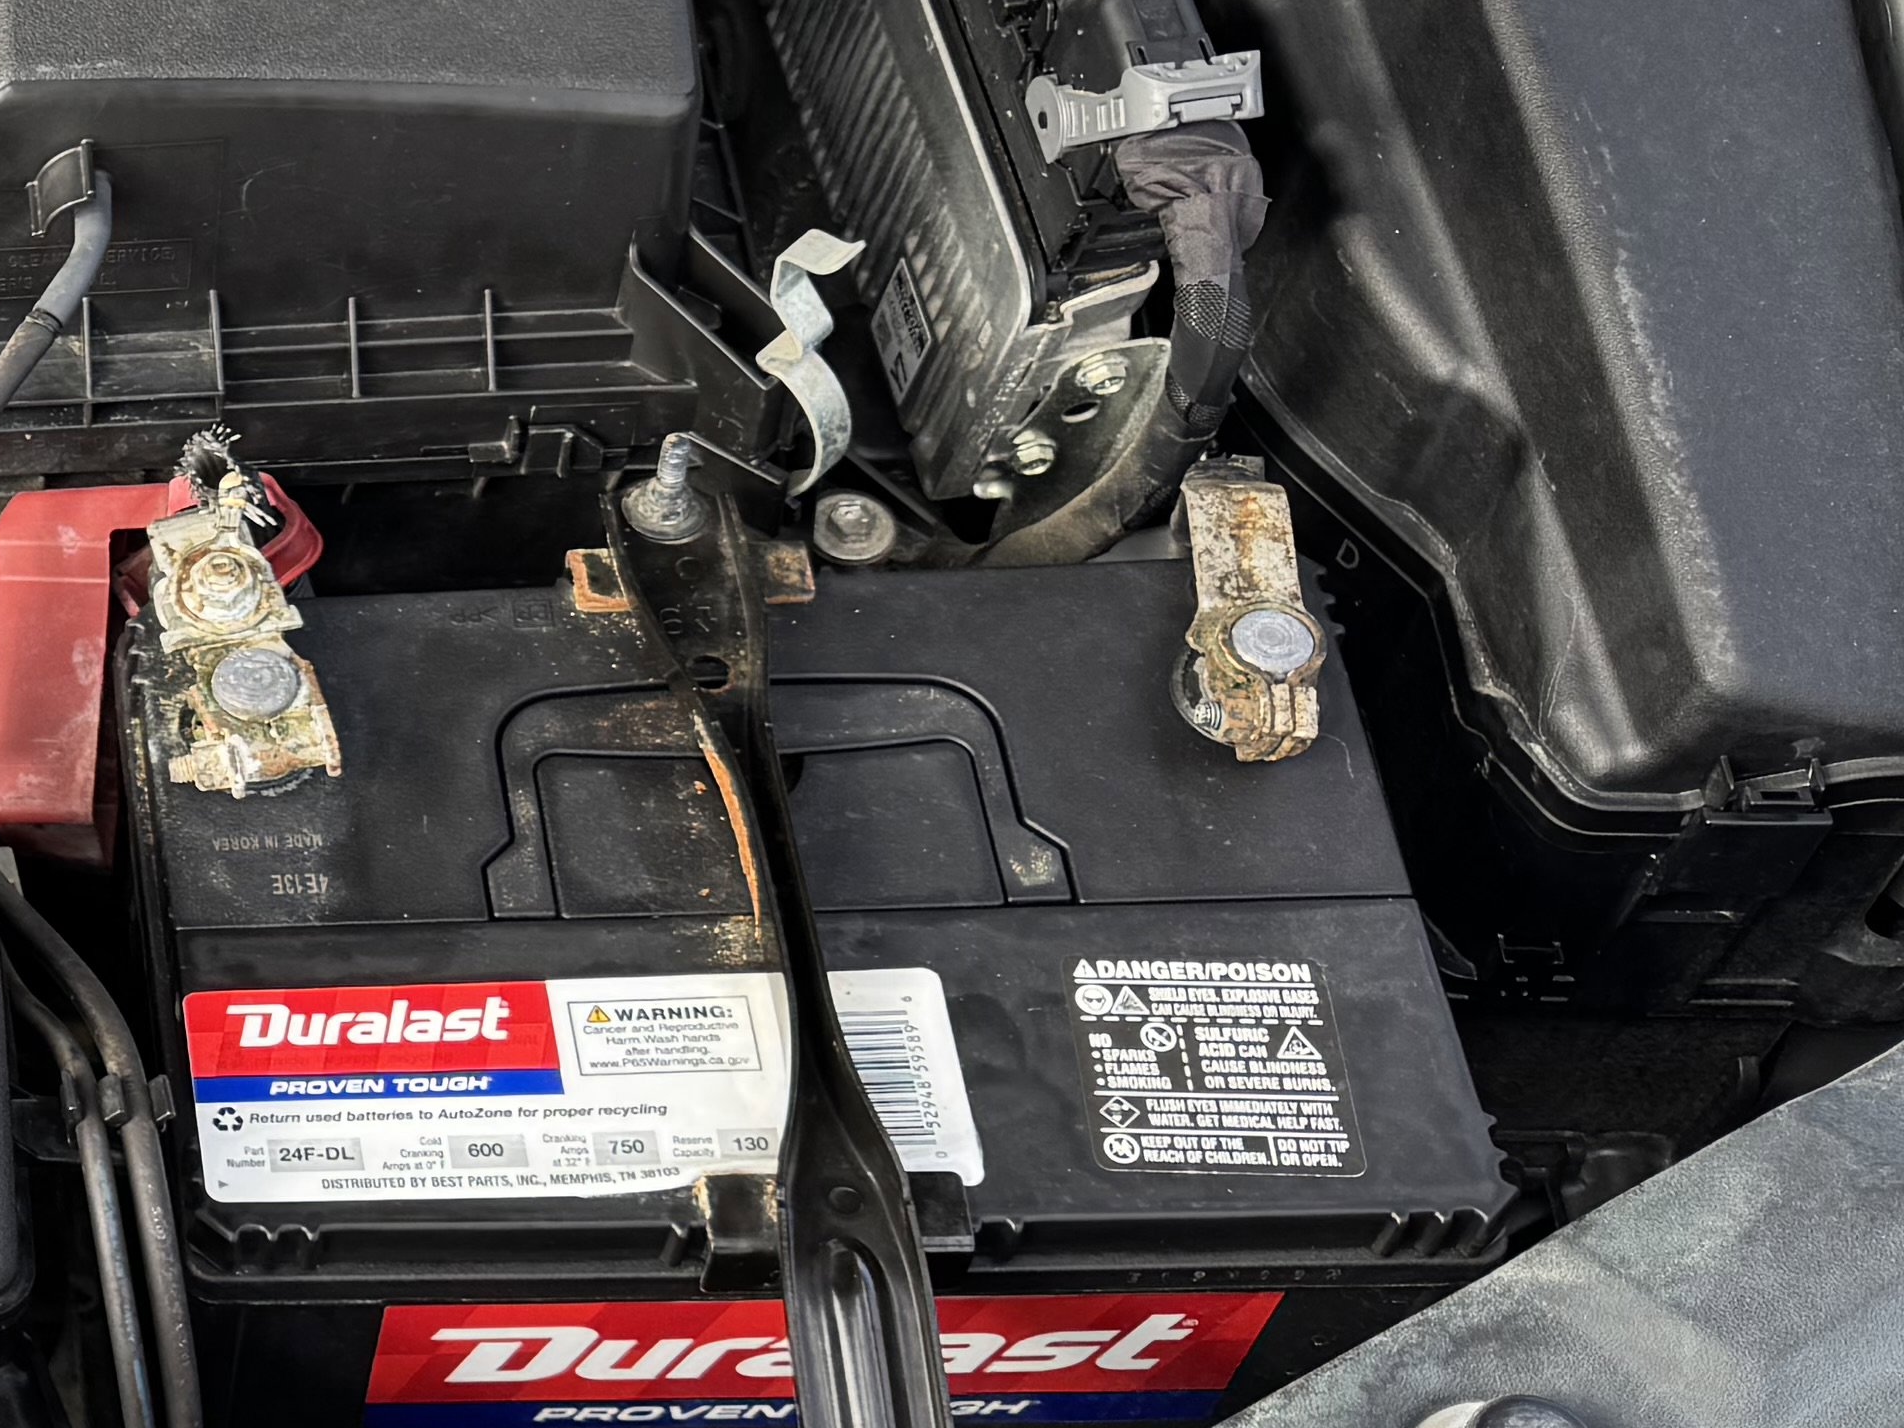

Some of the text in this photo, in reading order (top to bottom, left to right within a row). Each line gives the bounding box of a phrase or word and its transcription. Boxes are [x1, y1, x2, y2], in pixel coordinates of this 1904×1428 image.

[212, 833, 322, 851] MADE IN KOREA
[1095, 961, 1312, 982] DANGER/POISON
[1148, 988, 1187, 1001] SHIELD
[1221, 989, 1281, 1003] EXPLOSIVE
[615, 1006, 734, 1022] WARNING:
[1151, 1003, 1172, 1015] CAN
[1174, 1004, 1206, 1016] CAUSE
[1207, 1005, 1262, 1017] BLINDNESS
[1263, 1006, 1278, 1017] OR
[226, 995, 511, 1047] Duralast
[583, 1022, 739, 1035] Cancer and Reproductive
[644, 1033, 721, 1044] Wash hands
[1089, 1033, 1112, 1048] NO
[1194, 1027, 1270, 1042] SULFURIC
[625, 1046, 650, 1056] after
[904, 1025, 929, 1072] 59589
[1102, 1048, 1156, 1062] SPARKS
[1198, 1043, 1268, 1058] ACID CAN
[1105, 1062, 1160, 1075] FLAMES
[1201, 1059, 1327, 1075] CAUSE BLINDNESS
[270, 1076, 490, 1096] PROVEN TOUGH
[1107, 1076, 1172, 1090] SMOKING
[1204, 1077, 1336, 1092] OR SEVERE BURNS.
[916, 1081, 941, 1129] 52948
[1146, 1099, 1333, 1116] FLUSH EYES IMMEDIATELY WITH
[249, 1104, 668, 1124] Return used batteries to AutoZone for proper recycling
[1148, 1113, 1343, 1131] WATER. GET MEDICAL HELP FAST.
[419, 1136, 442, 1146] Cold
[542, 1134, 587, 1144] Cranking
[672, 1135, 712, 1145] Reserve
[733, 1137, 769, 1151] 130
[1140, 1135, 1245, 1151] KEEP OUT OF THE
[1278, 1139, 1350, 1153] DO NOT TIP
[244, 1146, 265, 1157] Part
[279, 1146, 355, 1163] 24F-DL
[400, 1148, 444, 1160] Cranking
[467, 1143, 504, 1159] 600
[560, 1146, 589, 1156] Amps
[609, 1139, 645, 1155] 750
[672, 1147, 715, 1158] Capacity
[936, 1151, 948, 1159] 0
[1143, 1149, 1271, 1165] REACH OF CHILDREN.
[1281, 1153, 1343, 1167] OR OPEN.
[227, 1158, 266, 1169] Number
[383, 1160, 412, 1171] Amps
[415, 1161, 424, 1170] at
[553, 1159, 561, 1167] at
[322, 1177, 406, 1190] DISTRIBUTED
[411, 1176, 427, 1188] BY
[432, 1176, 464, 1188] BEST
[468, 1175, 513, 1188] PARTS,
[550, 1171, 616, 1185] MEMPHIS,
[619, 1170, 637, 1181] TN
[640, 1167, 680, 1179] 38103
[431, 1313, 1193, 1384] Duraast
[532, 1401, 794, 1424] PROVEN
